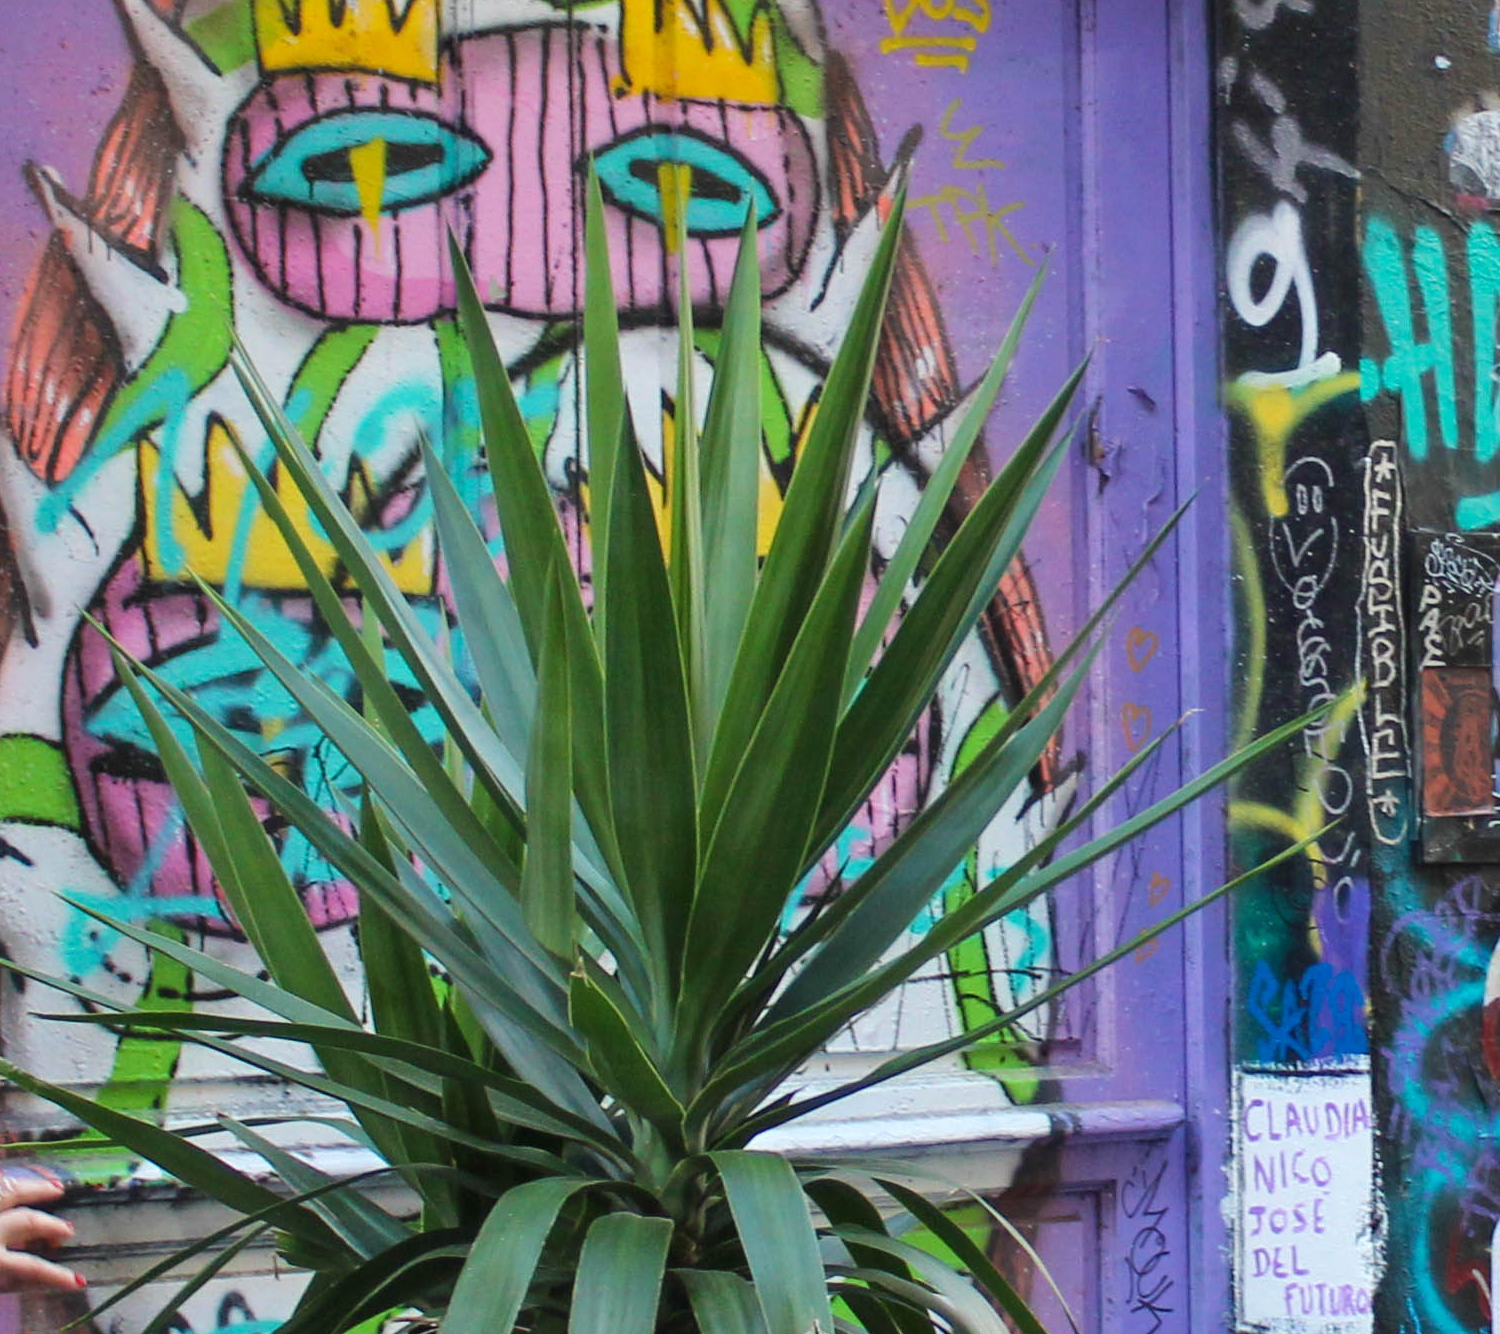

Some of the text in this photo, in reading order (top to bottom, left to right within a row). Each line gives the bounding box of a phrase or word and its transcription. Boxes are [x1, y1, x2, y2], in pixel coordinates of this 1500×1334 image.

[1245, 1098, 1372, 1143] CLAUDIA
[1253, 1151, 1333, 1196] NICO
[1252, 1247, 1311, 1279] DEL
[1284, 1282, 1372, 1318] FUTURO
